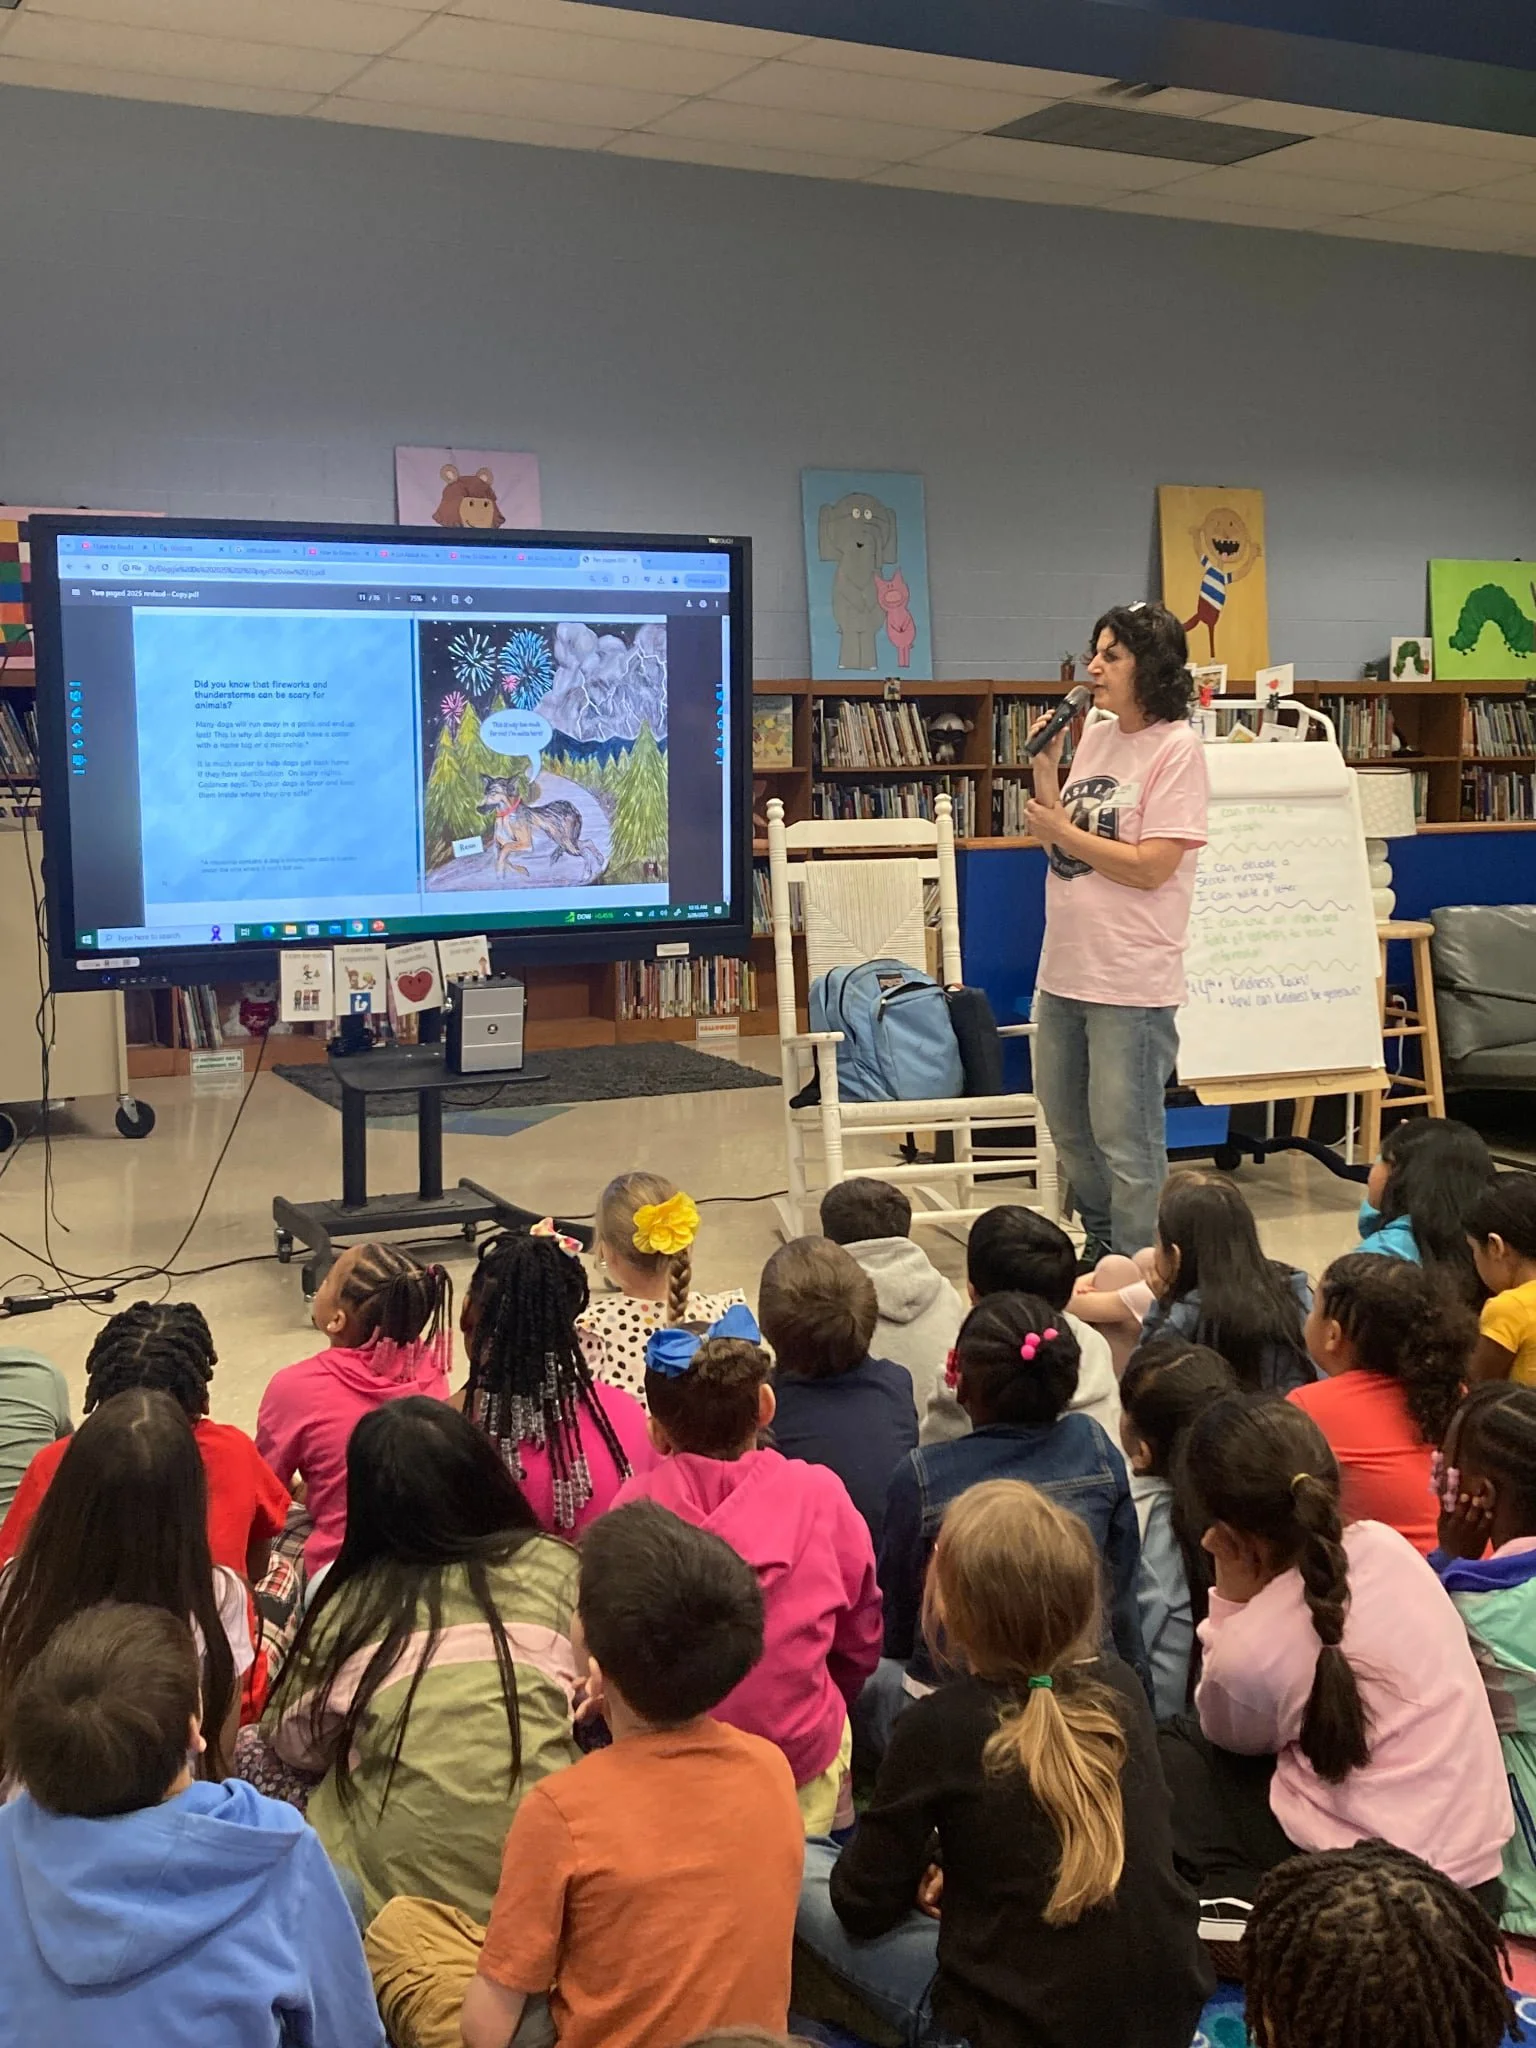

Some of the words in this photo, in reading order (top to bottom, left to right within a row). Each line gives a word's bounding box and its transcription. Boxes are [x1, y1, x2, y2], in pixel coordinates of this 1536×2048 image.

[194, 680, 209, 689] Did
[211, 681, 226, 690] you
[229, 680, 250, 688] know
[253, 680, 270, 688] that
[272, 680, 310, 689] fireworks
[313, 680, 328, 689] and
[195, 691, 255, 699] thunderstorms
[275, 691, 286, 699] be
[288, 692, 310, 700] scary
[313, 691, 325, 699] for
[195, 701, 232, 709] animals?
[196, 721, 214, 729] Many
[217, 721, 234, 729] dogs
[213, 730, 229, 738] This
[239, 731, 253, 739] why
[992, 796, 1001, 813] N
[160, 931, 181, 940] search
